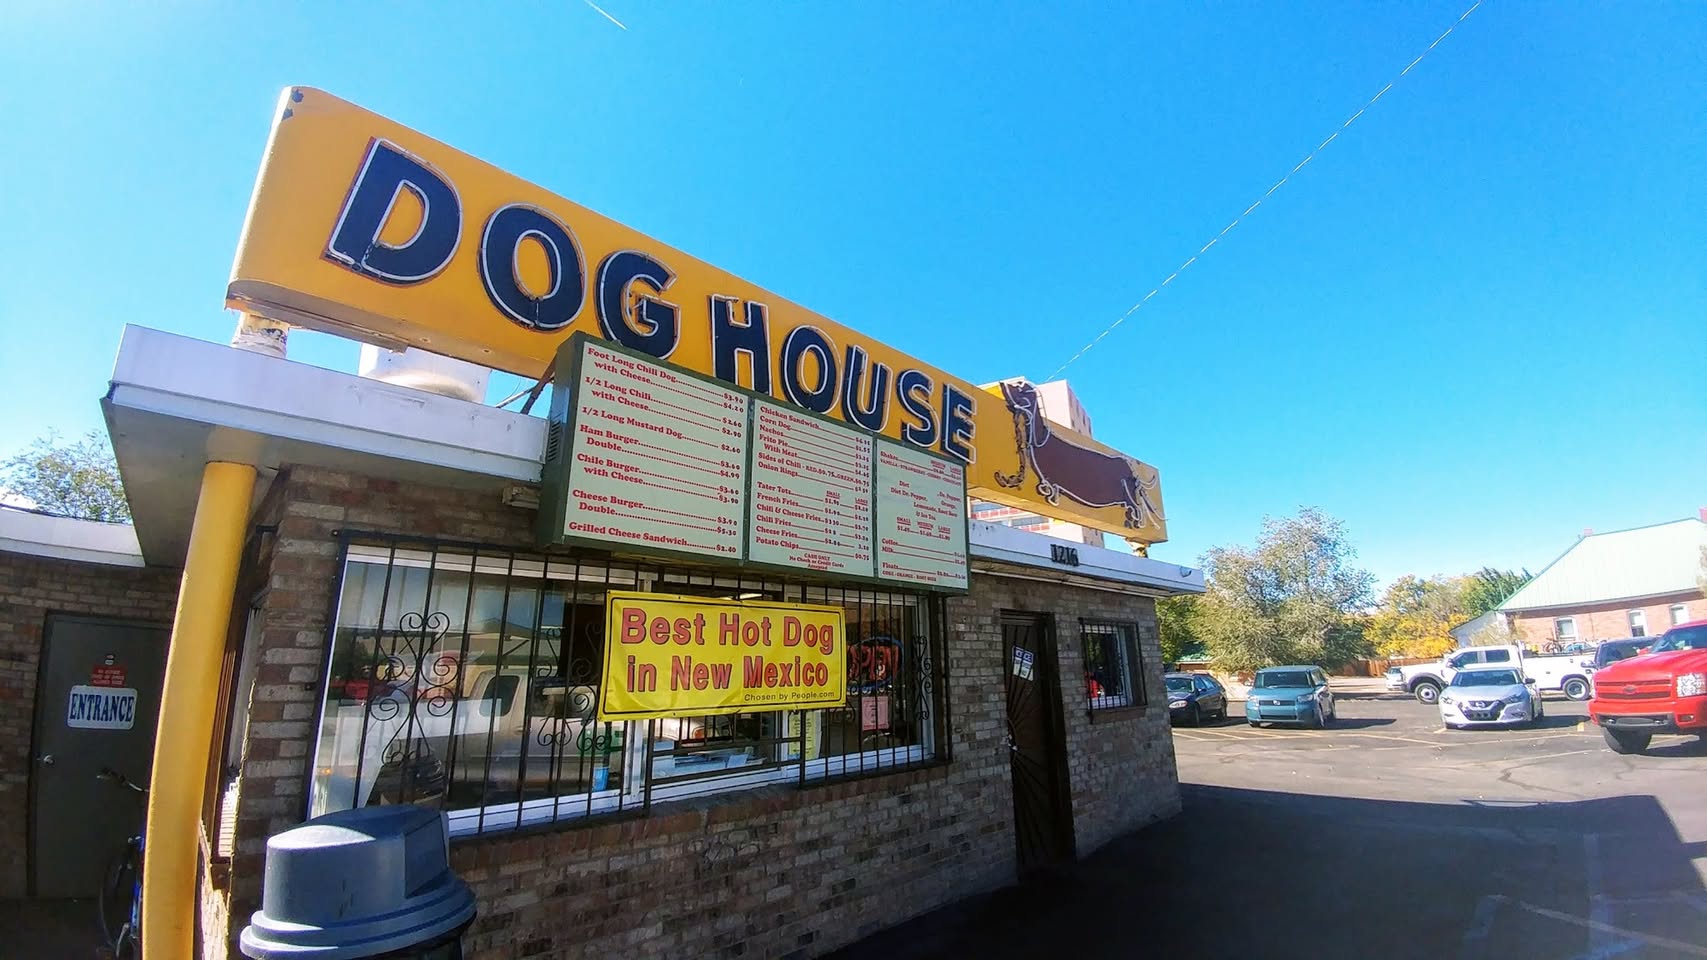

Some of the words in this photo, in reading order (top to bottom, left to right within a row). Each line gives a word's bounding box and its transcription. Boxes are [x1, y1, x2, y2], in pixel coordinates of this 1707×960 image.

[319, 136, 681, 361] DOG
[707, 293, 978, 465] HOUSE
[587, 347, 610, 360] Foot
[612, 355, 635, 369] Long
[636, 363, 658, 376] Chili
[660, 370, 677, 384] Dog
[723, 392, 743, 404] $3.90
[594, 361, 618, 374] with
[620, 368, 651, 384] Cheese
[585, 376, 601, 386] 1/2
[604, 380, 627, 395] Long
[629, 388, 651, 400] Chili
[591, 390, 615, 401] with
[617, 396, 649, 411] Cheese
[581, 406, 599, 416] 1/2
[601, 410, 625, 424] Long
[626, 417, 664, 433] Mustard
[665, 425, 683, 440] Dog
[759, 415, 777, 426] Corn
[778, 422, 793, 431] Dog
[760, 406, 788, 420] Chicken
[789, 414, 820, 430] Sandwich
[579, 424, 603, 436] Ham
[606, 430, 639, 446] Burger
[759, 424, 784, 437] Nachos
[586, 436, 622, 452] Double
[759, 433, 777, 444] Frito
[778, 439, 788, 447] Pie
[764, 443, 781, 454] With
[782, 449, 798, 458] Meat
[577, 453, 604, 466] Chile
[606, 459, 640, 473] Burger
[758, 452, 776, 462] Sides
[785, 460, 801, 469] Chili
[584, 467, 608, 477] with
[611, 471, 644, 484] Cheese
[758, 462, 779, 472] Onion
[780, 466, 798, 477] Rings
[757, 481, 776, 492] Tater
[777, 485, 792, 495] Tots
[890, 487, 901, 495] Diet
[899, 480, 910, 488] Diet
[572, 489, 607, 503] Cheese
[610, 496, 644, 509] Burger
[757, 492, 781, 504] French
[782, 497, 799, 507] Fries
[578, 501, 616, 515] Double
[782, 508, 804, 519] Cheese
[805, 513, 822, 522] Fries
[774, 517, 792, 527] Fries
[568, 521, 606, 534] Grilled
[608, 527, 641, 540] Cheese
[642, 532, 688, 546] Sandwich
[756, 525, 781, 536] Cheese
[781, 530, 798, 539] Fries
[755, 536, 779, 547] Potato
[780, 540, 800, 550] Chips
[881, 538, 898, 546] Coffee
[1050, 544, 1079, 566] 1216
[620, 607, 706, 646] Best
[719, 613, 772, 647] Hot
[783, 616, 834, 655] Dog
[627, 655, 657, 692] in
[670, 655, 732, 691] New
[743, 656, 829, 689] Mexico
[744, 693, 776, 702] Chosen
[778, 693, 789, 702] by
[791, 690, 835, 700] People.com
[69, 693, 135, 722] ENTRANCE
